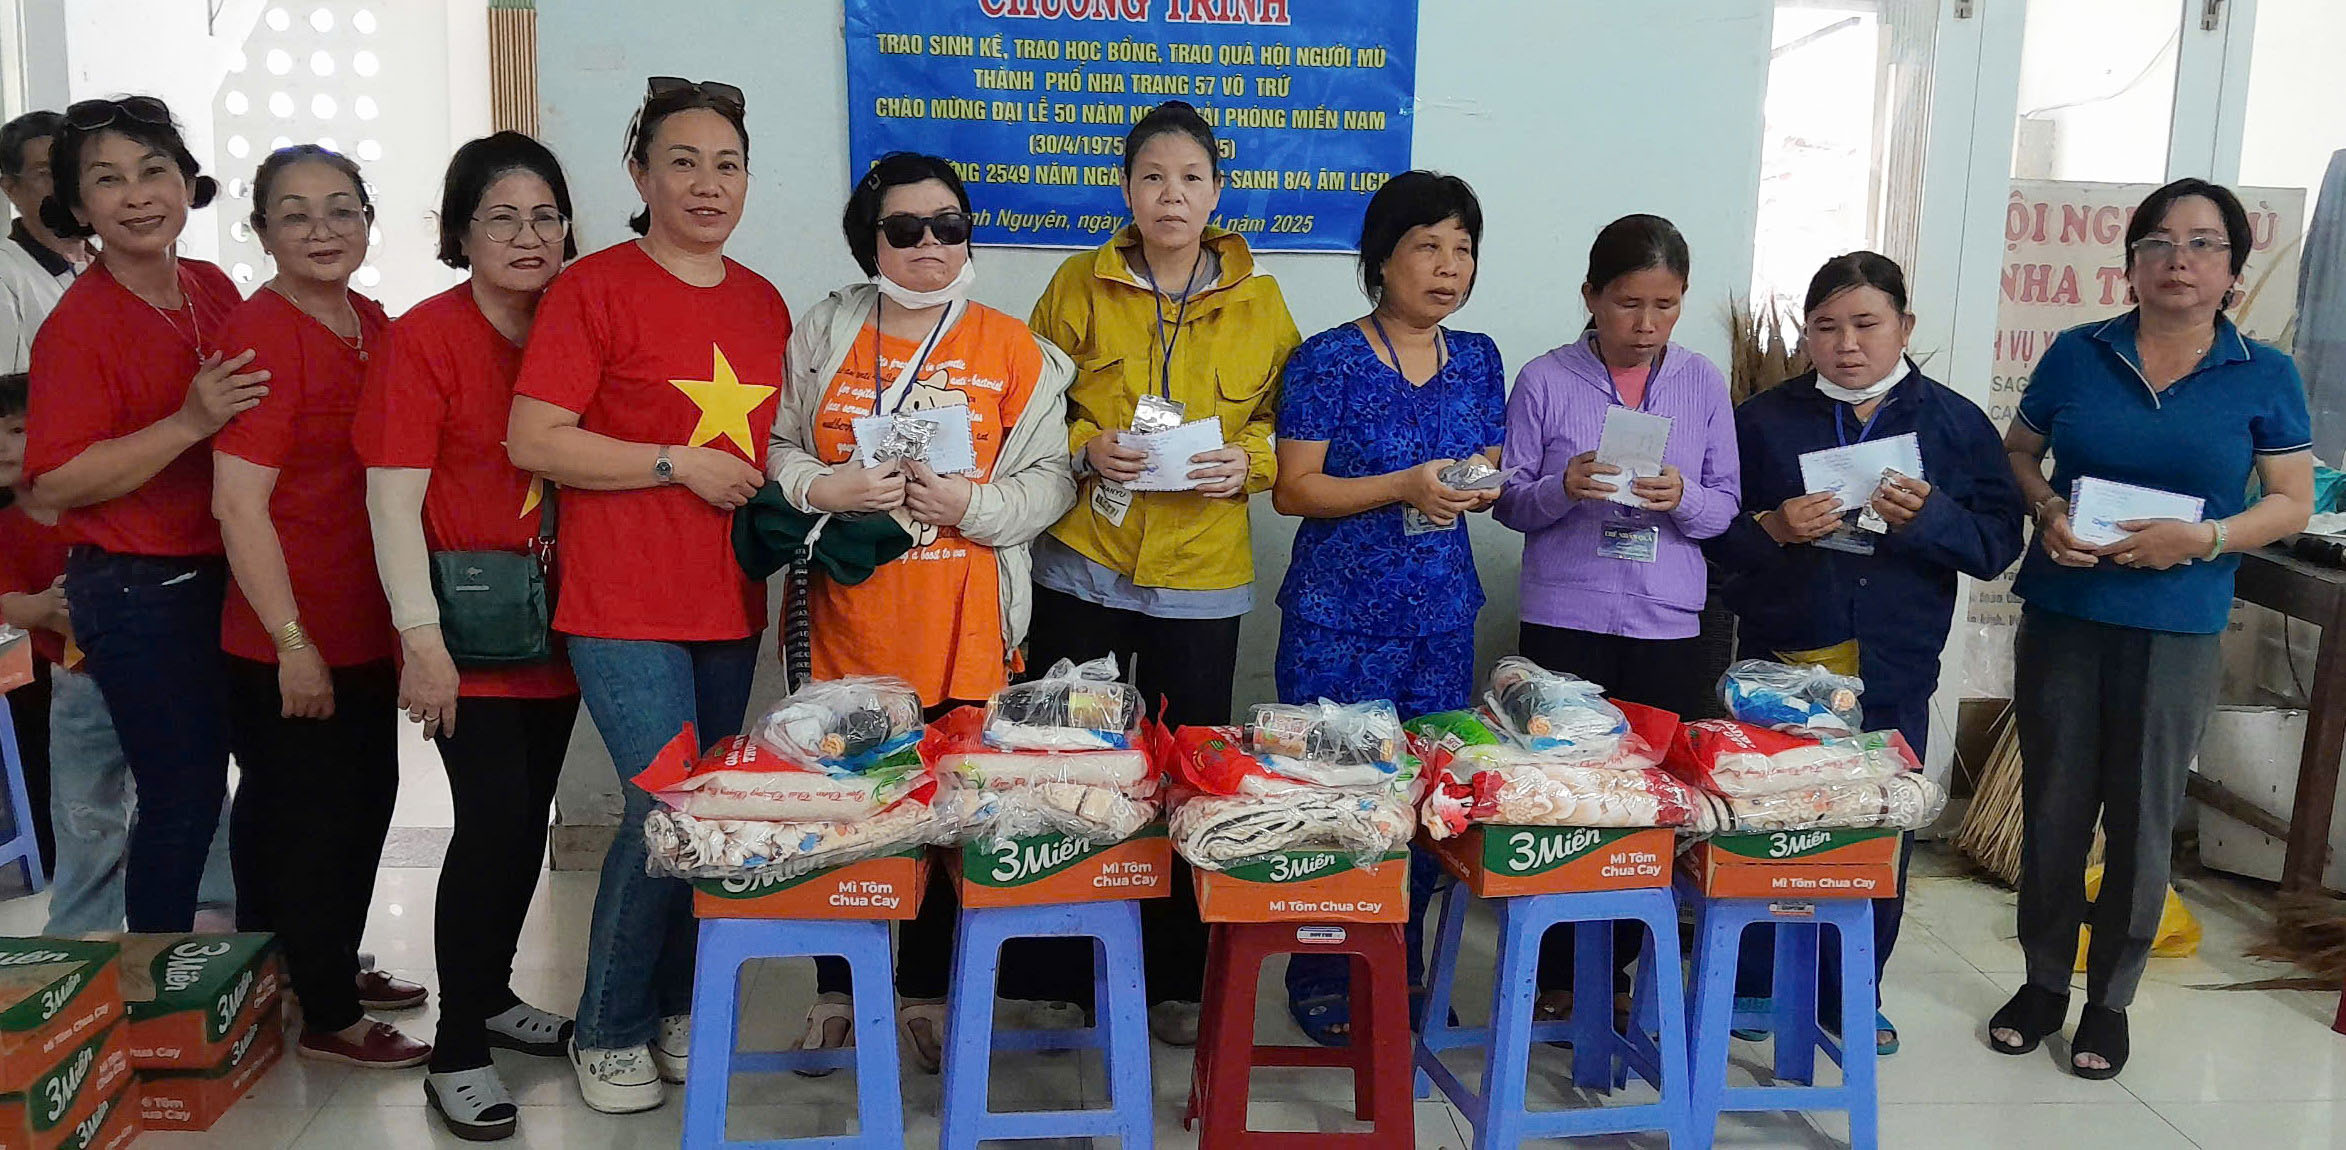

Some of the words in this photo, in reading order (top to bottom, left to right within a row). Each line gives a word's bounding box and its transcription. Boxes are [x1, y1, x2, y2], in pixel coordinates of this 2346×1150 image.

[876, 33, 923, 55] TRAO
[929, 35, 973, 57] SINH
[1014, 39, 1059, 60] TRAO
[1065, 40, 1101, 65] HỌC
[1169, 43, 1213, 64] TRAO
[1218, 42, 1255, 66] QUÀ
[1261, 43, 1291, 70] HỘI
[1296, 43, 1351, 68] NGƯỜI
[1357, 45, 1387, 69] MÙ
[974, 66, 1035, 91] THÀNH
[1045, 66, 1082, 92] PHỐ
[1088, 73, 1125, 93] NHA
[1131, 74, 1189, 95] TRANG
[1194, 76, 1216, 95] 57
[1222, 73, 1245, 97] VÕ
[1256, 74, 1292, 97] TRỨ
[875, 94, 925, 118] CHÀO
[931, 95, 986, 120] MỪNG
[992, 101, 1023, 124] ĐẠI
[1054, 104, 1076, 123] 50
[1082, 102, 1124, 124] NĂM
[1225, 104, 1286, 128] PHÓNG
[1291, 104, 1339, 129] MIỀN
[1344, 110, 1386, 129] NAM
[986, 163, 1030, 184] 2549
[1035, 162, 1078, 185] NĂM
[1083, 164, 1124, 186] NGÀ
[1231, 170, 1278, 190] SANH
[1284, 171, 1311, 191] 8/4
[1317, 168, 1345, 190] ÂM
[996, 209, 1071, 233] Nguyên,
[1077, 210, 1124, 235] ngày
[1226, 214, 1265, 232] năm
[1270, 215, 1314, 234] 2025
[2005, 190, 2048, 250] ỘI
[2248, 201, 2278, 250] Ù
[1610, 853, 1626, 864] Mì
[1628, 852, 1656, 864] Tôm
[1102, 862, 1119, 875] Mì
[1122, 861, 1152, 874] Tôm
[1601, 865, 1635, 877] Chua
[1637, 864, 1661, 877] Cay
[838, 880, 857, 893] Mì
[859, 880, 893, 894] Tôm
[1093, 875, 1129, 888] Chua
[1132, 875, 1158, 887] Cay
[1772, 878, 1789, 888] Mì
[1790, 877, 1816, 888] Tôm
[1818, 877, 1850, 888] Chua
[1853, 878, 1876, 890] Cay
[829, 894, 867, 907] Chua
[870, 894, 900, 908] Cay
[1269, 901, 1286, 912] Mì
[1288, 901, 1316, 912] Tôm
[1320, 901, 1354, 912] Chua
[1357, 902, 1382, 914] Cay
[130, 1048, 153, 1058] hua
[156, 1048, 181, 1059] Cay
[164, 1110, 191, 1122] Cay
